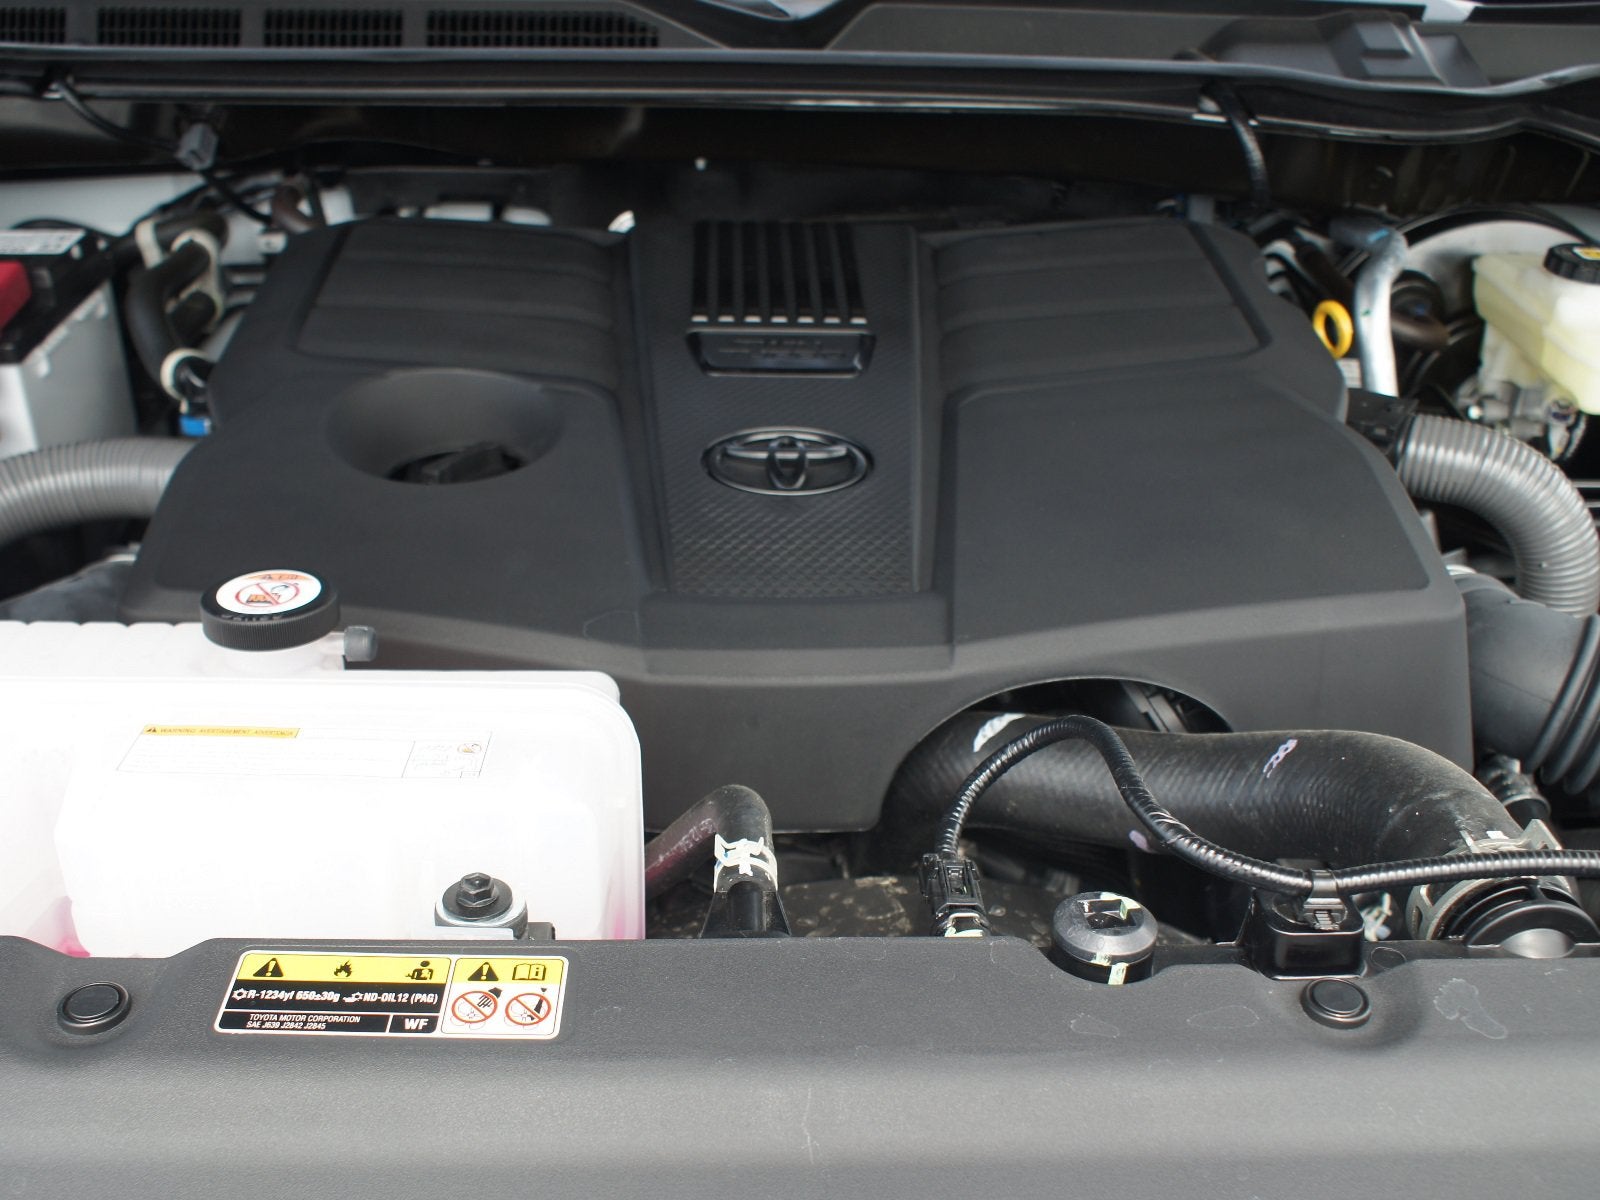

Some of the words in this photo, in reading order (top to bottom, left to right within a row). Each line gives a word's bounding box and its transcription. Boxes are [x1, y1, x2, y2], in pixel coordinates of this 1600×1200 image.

[247, 989, 295, 1001] R-1234yf
[410, 993, 438, 1005] (PAG)
[249, 1013, 277, 1021] TOYOTA
[278, 1014, 306, 1022] MOTOR
[307, 1015, 361, 1023] CORPORATION
[304, 1022, 326, 1030] J2845
[404, 1018, 429, 1030] WF
